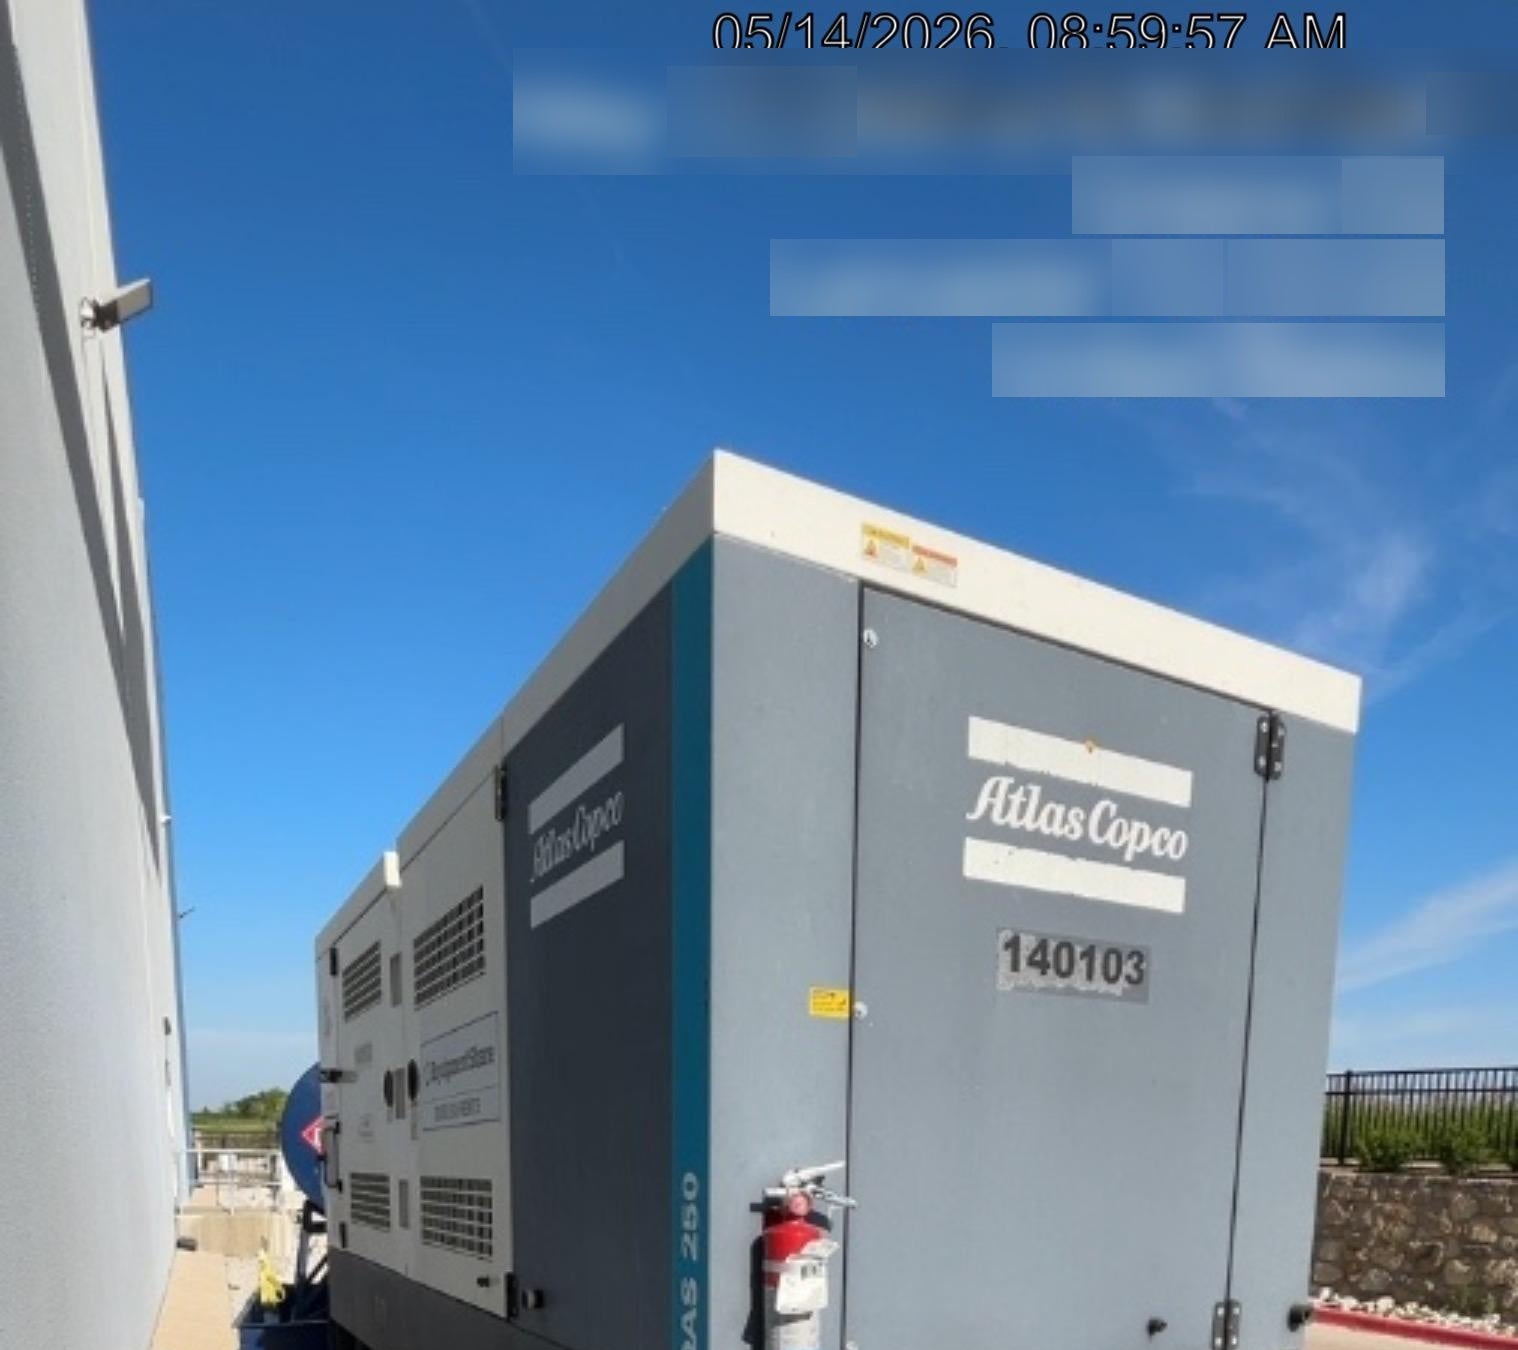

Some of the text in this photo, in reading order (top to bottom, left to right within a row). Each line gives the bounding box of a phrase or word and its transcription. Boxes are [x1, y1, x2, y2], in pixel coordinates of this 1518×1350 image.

[966, 776, 1189, 862] Atlas Copco
[1004, 934, 1145, 985] 140103
[680, 1172, 699, 1262] 250
